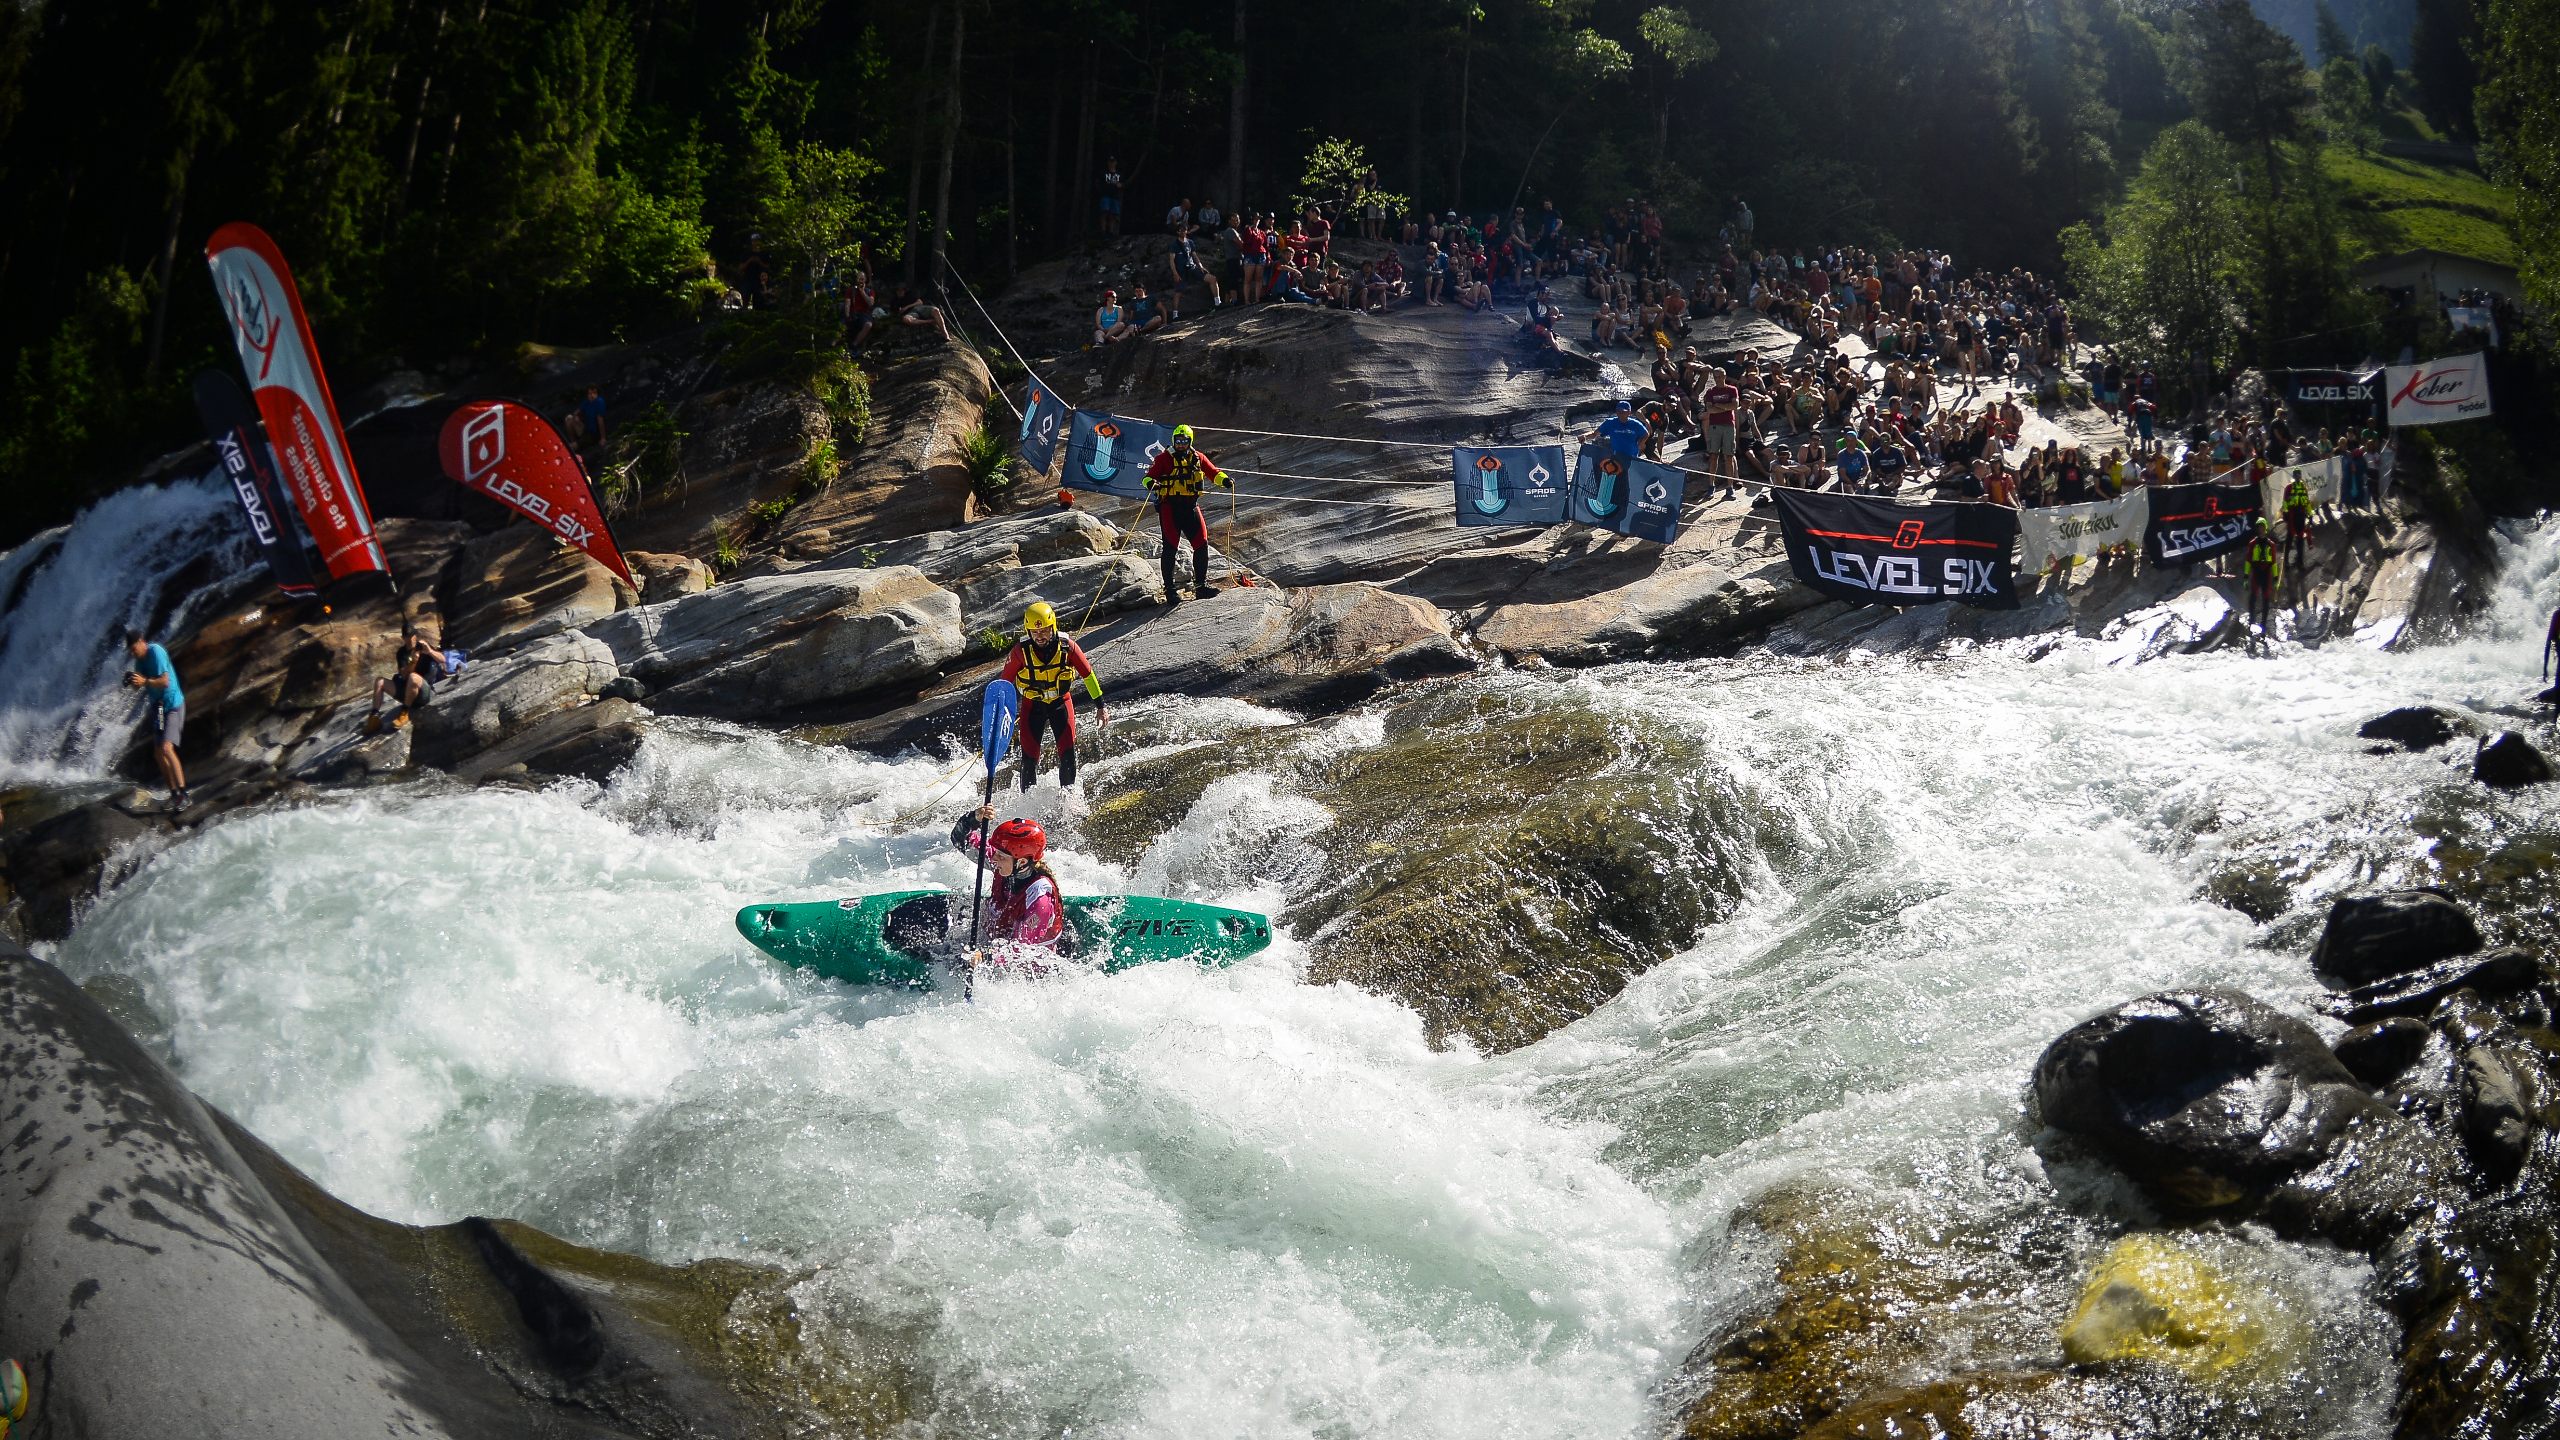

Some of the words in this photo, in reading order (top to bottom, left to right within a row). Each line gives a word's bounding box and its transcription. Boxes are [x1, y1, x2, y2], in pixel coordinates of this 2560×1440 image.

[2298, 386, 2345, 400] LEVEL
[2347, 385, 2374, 400] SIX
[2391, 369, 2477, 408] Kober
[1525, 487, 1556, 495] SPADE
[485, 472, 553, 524] LEVEL
[554, 513, 595, 549] SIX
[1637, 501, 1668, 514] SPADE
[2157, 524, 2227, 558] LEVEL
[2219, 512, 2252, 540] SIX
[1808, 545, 1937, 594] LEVEL
[1943, 558, 1998, 595] SIX
[1117, 919, 1196, 938] FIVE
